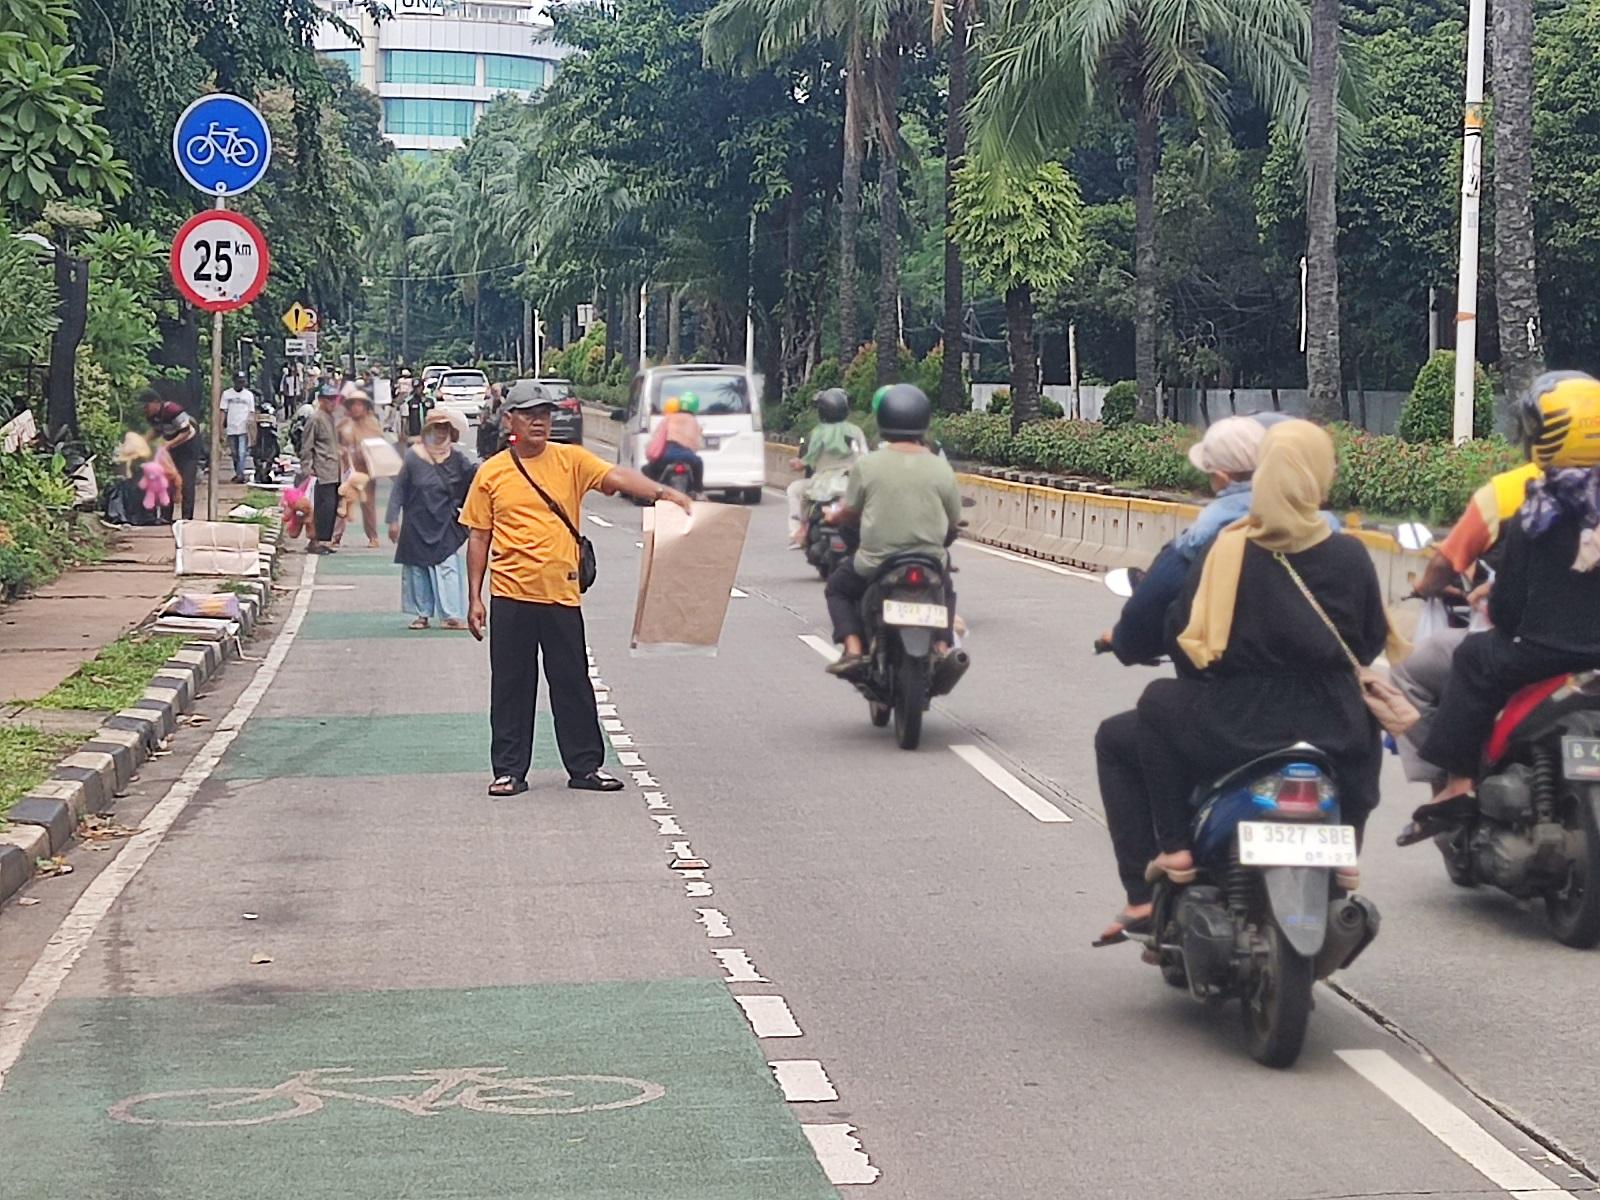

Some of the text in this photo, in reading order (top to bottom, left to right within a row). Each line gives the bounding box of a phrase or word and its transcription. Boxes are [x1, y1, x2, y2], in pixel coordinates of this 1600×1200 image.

[235, 241, 252, 256] km
[194, 240, 233, 283] 25
[1573, 743, 1585, 758] B
[1243, 825, 1352, 845] B 3527 SBE
